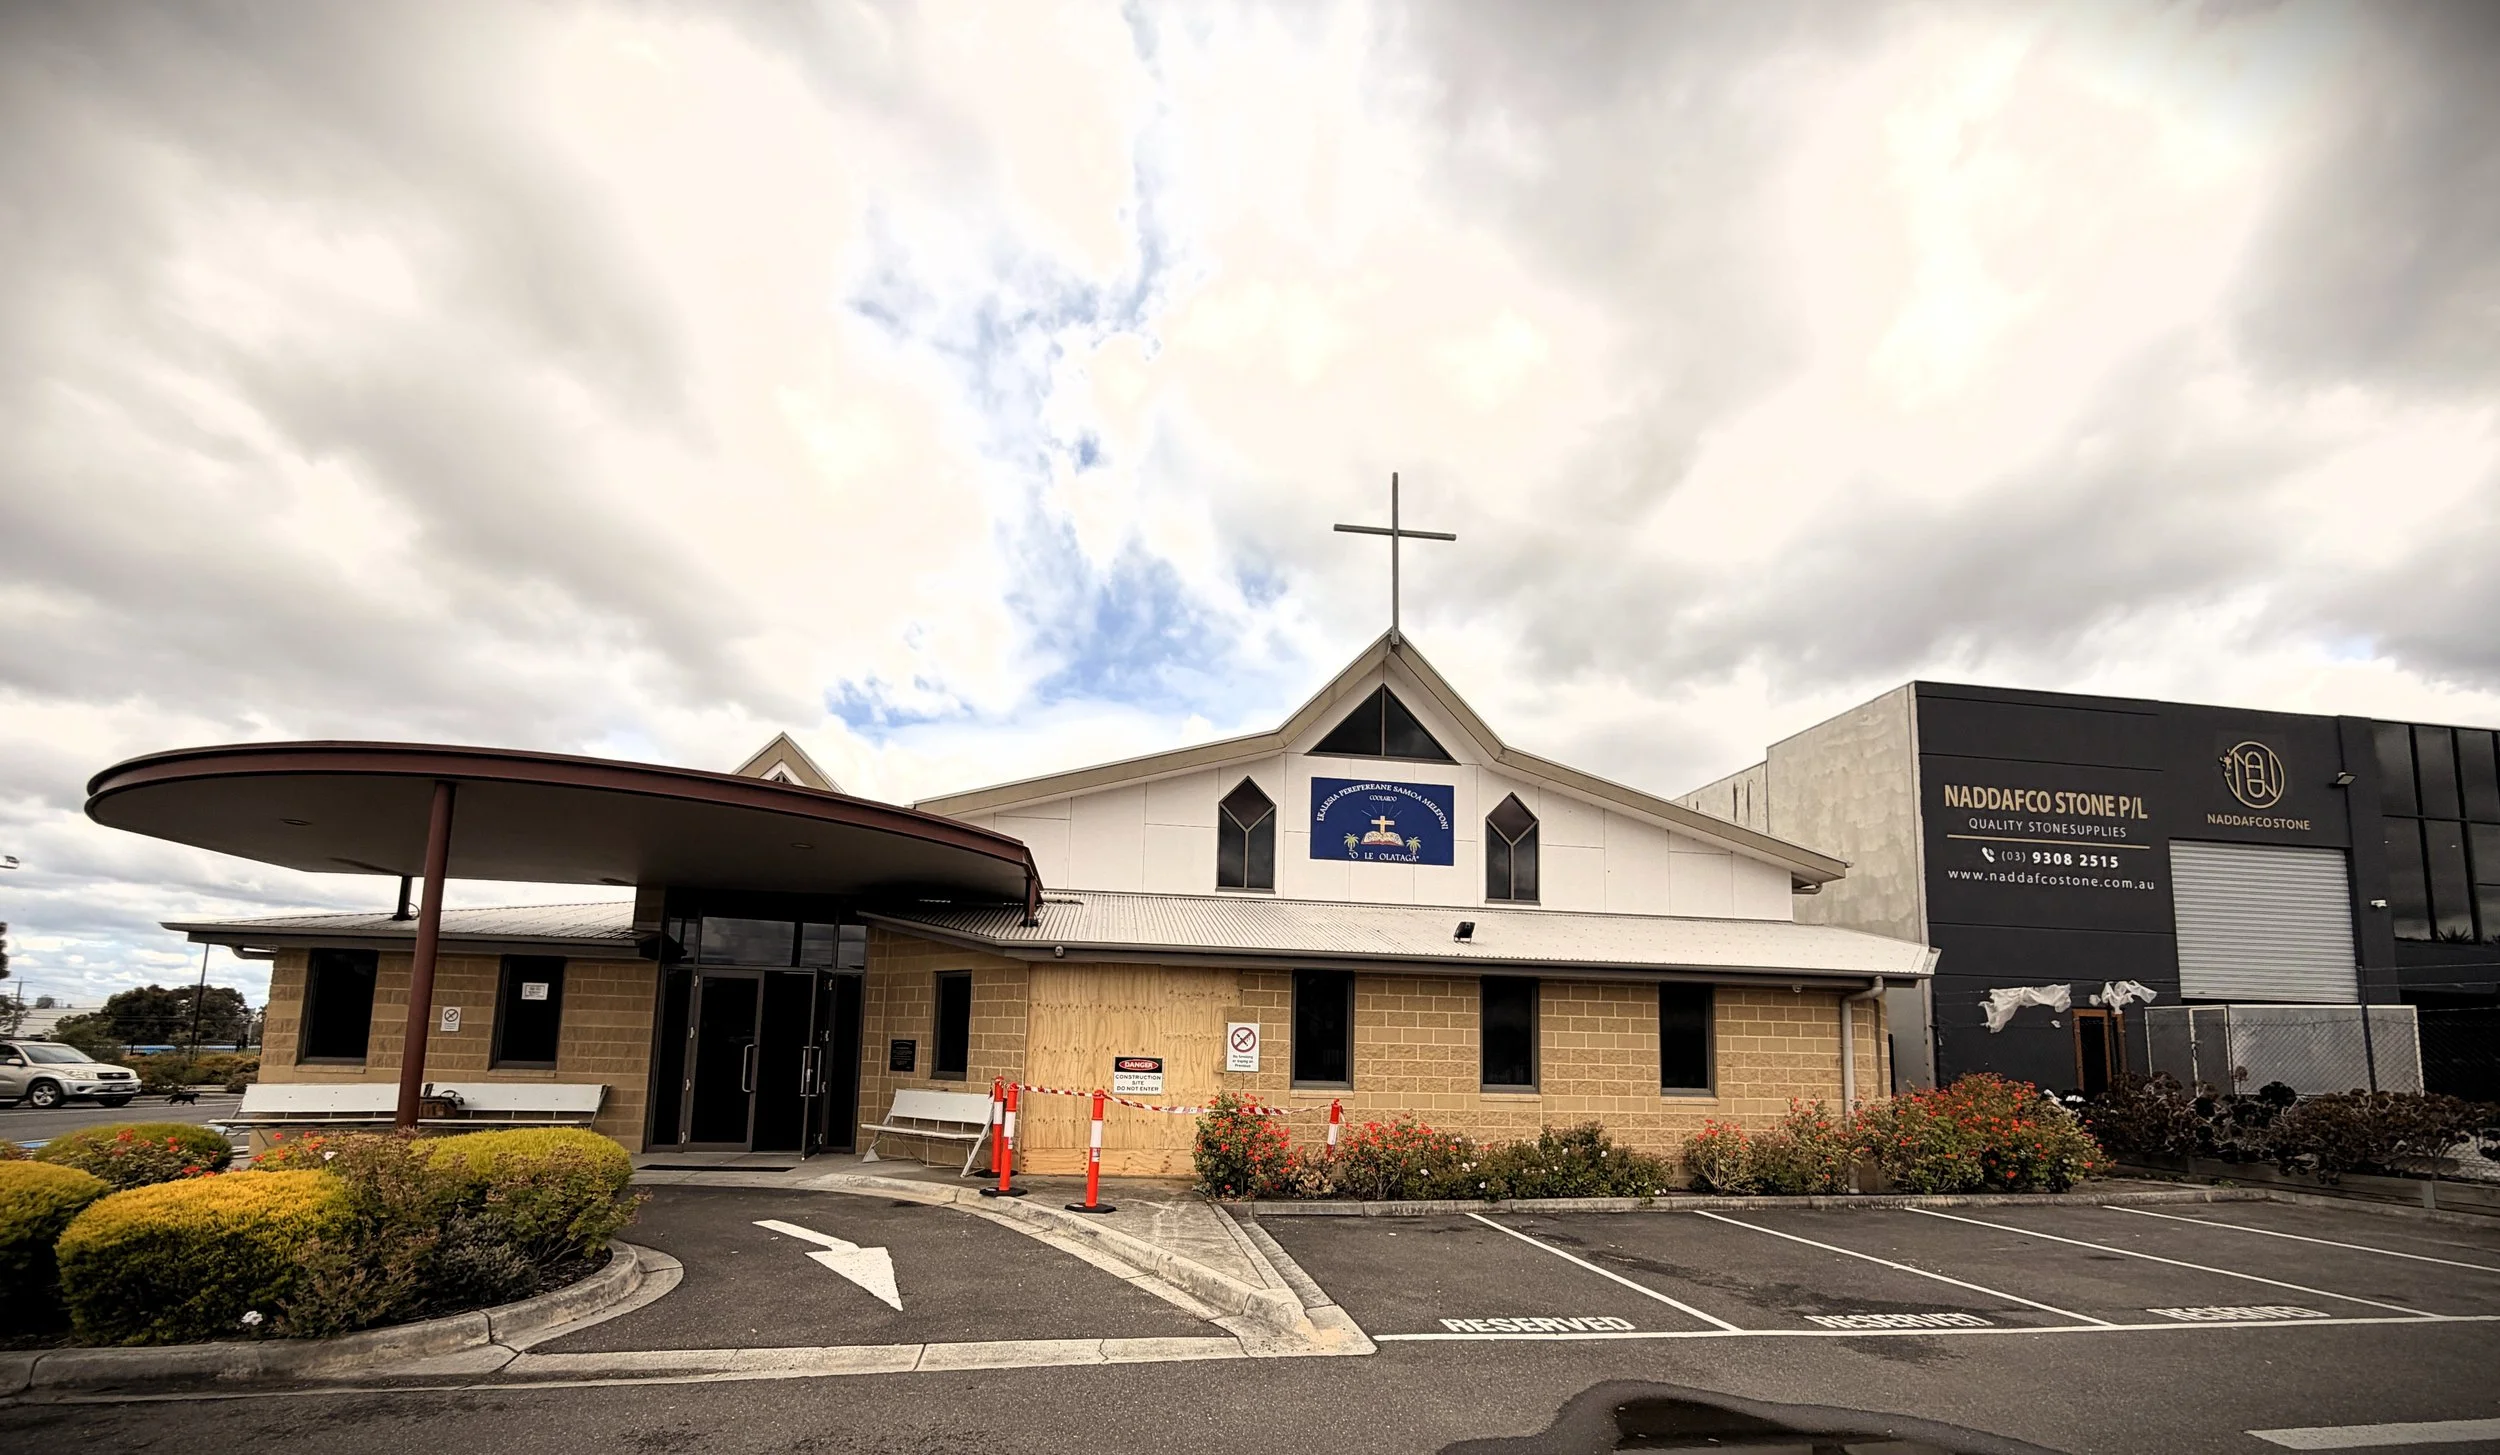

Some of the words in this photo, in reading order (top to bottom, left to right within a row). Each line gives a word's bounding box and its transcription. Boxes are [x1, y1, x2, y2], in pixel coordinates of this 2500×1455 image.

[1316, 795, 1340, 822] EKALESIA
[1338, 783, 1392, 797] PEREPEREANE
[1393, 786, 1422, 802] SAMOA
[1421, 798, 1449, 830] MELEFONI
[1944, 784, 2052, 814] NADDAFCO
[2055, 791, 2116, 818] STONE
[2119, 799, 2148, 820] P/L
[1968, 818, 2023, 833] QUALITY
[1364, 852, 1374, 860] LE
[2001, 851, 2026, 863] (03)
[2032, 852, 2073, 866] 9308
[2079, 854, 2119, 869] 2515
[1947, 869, 2155, 891] www.naddafcostone.com.au
[1804, 1312, 1995, 1329] RESERVED
[2147, 1305, 2331, 1322] RESERVED
[1440, 1316, 1636, 1334] RESERVED
